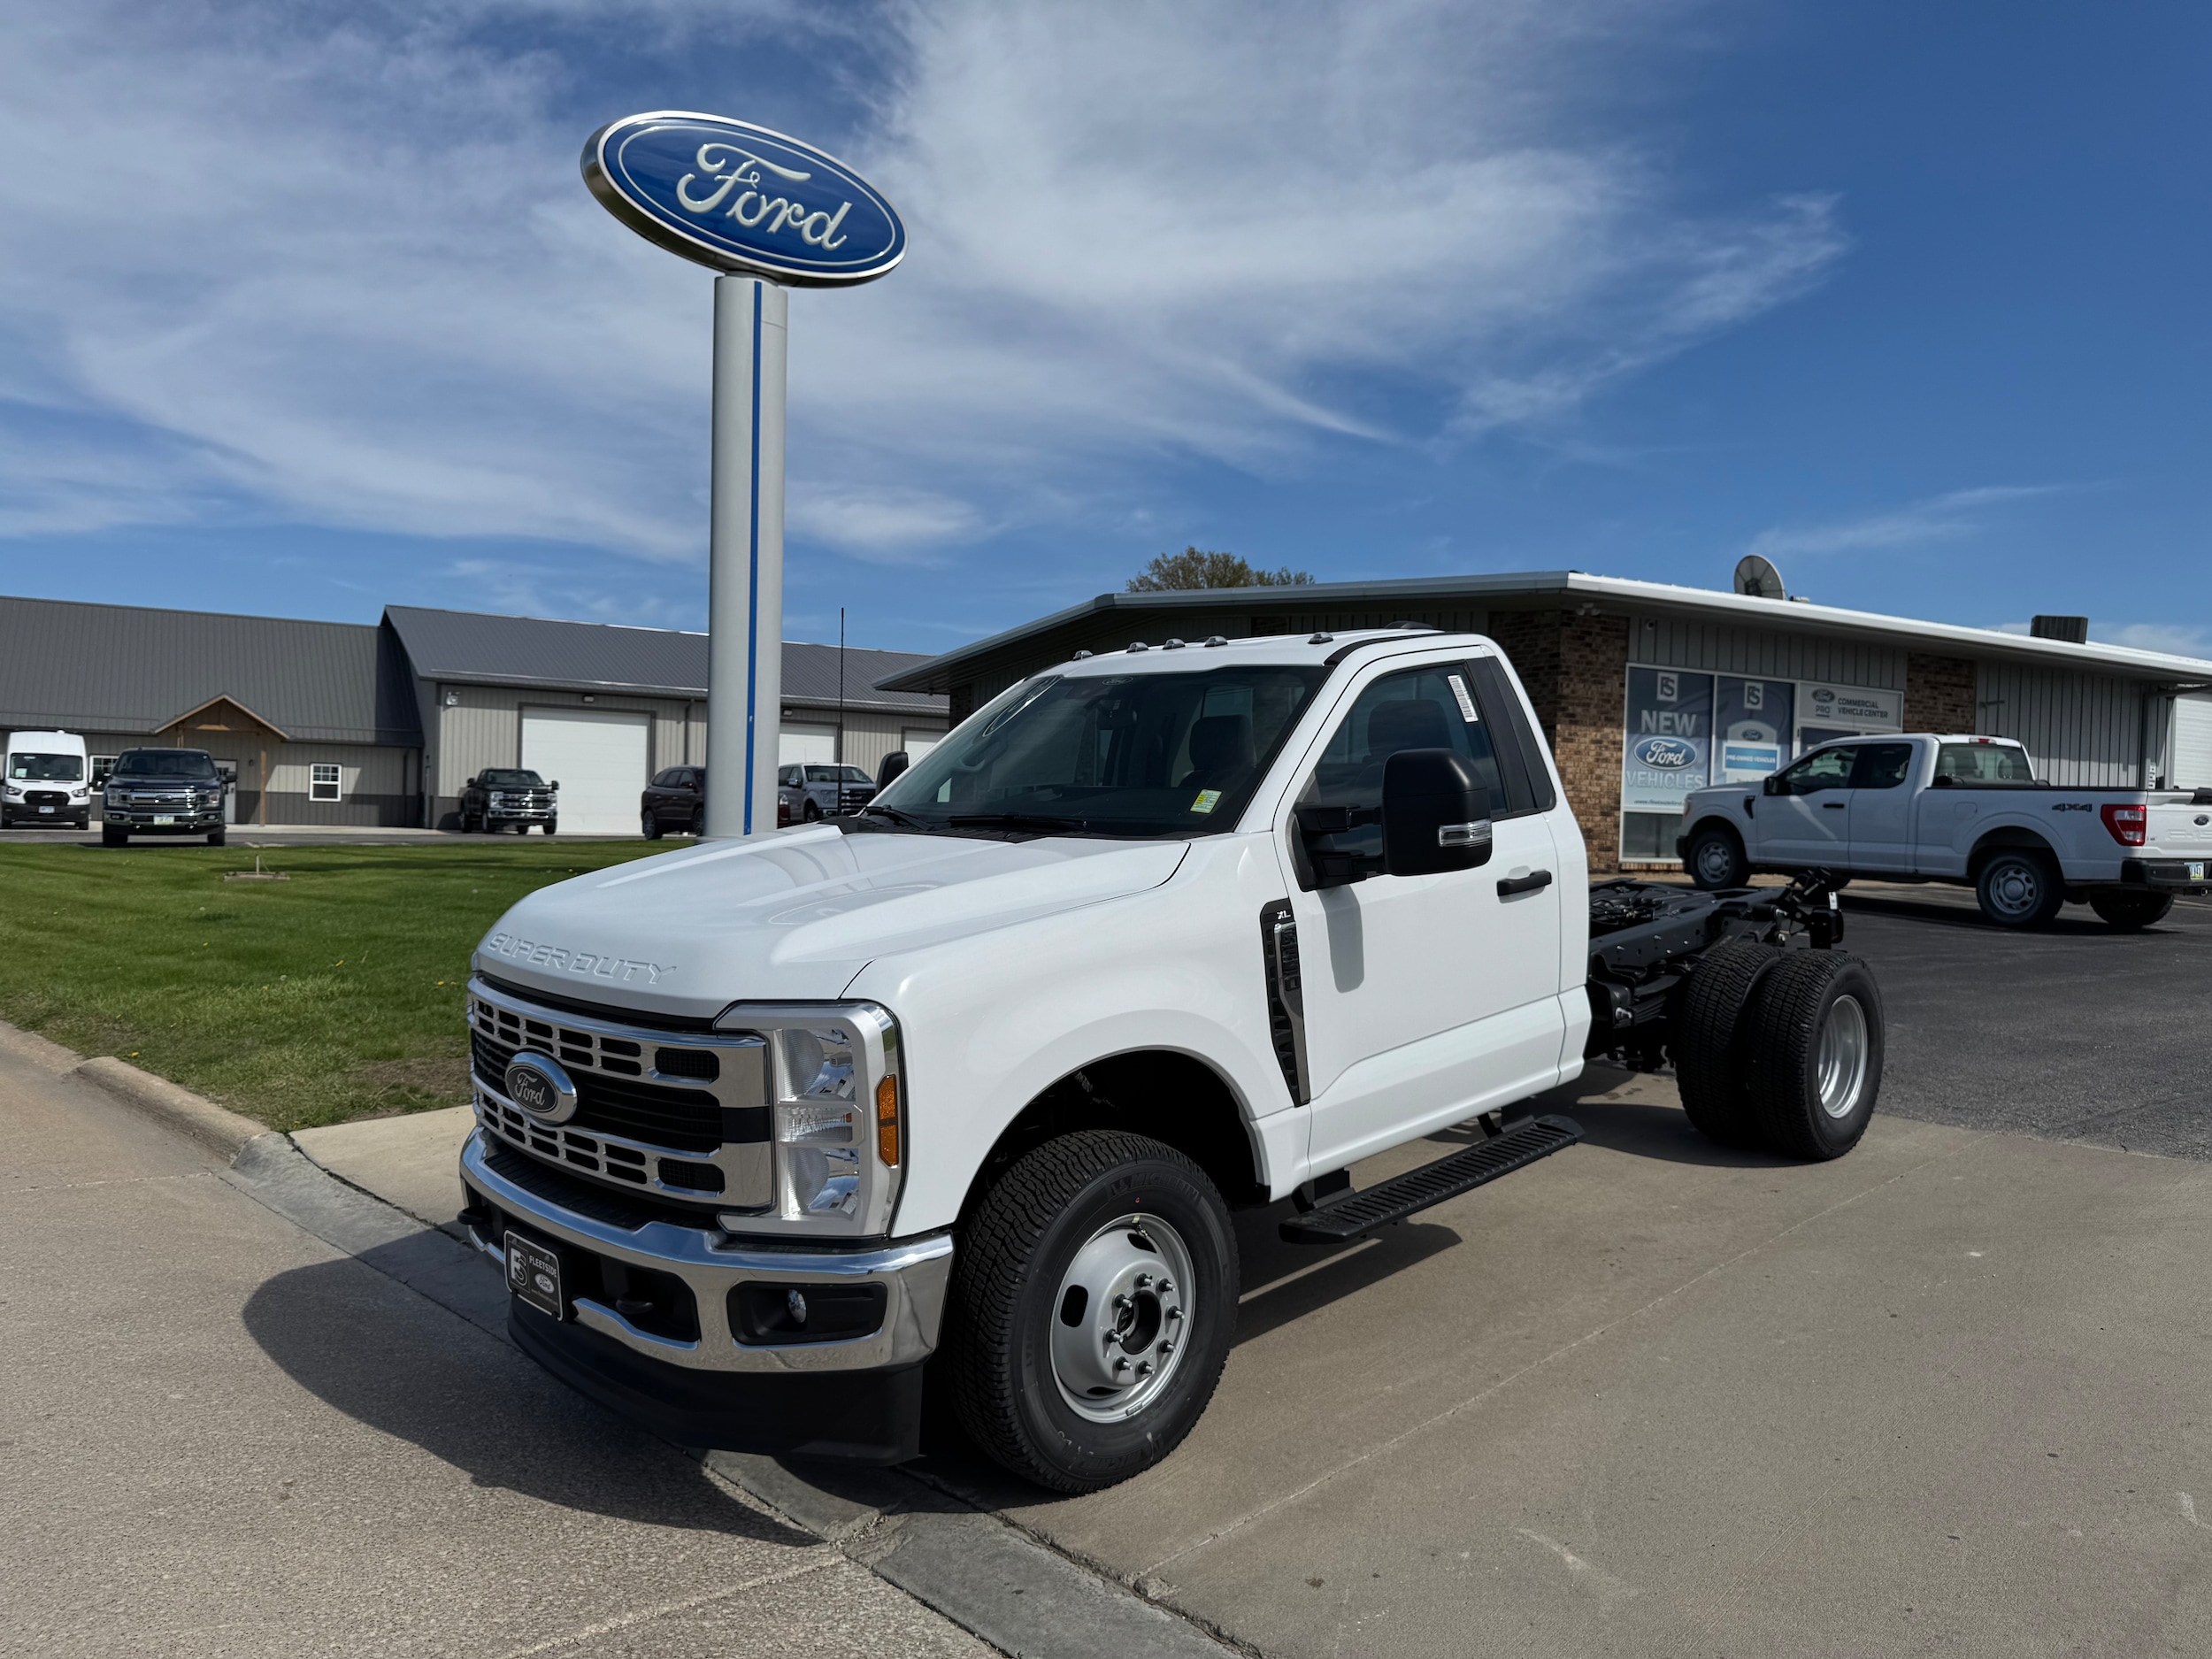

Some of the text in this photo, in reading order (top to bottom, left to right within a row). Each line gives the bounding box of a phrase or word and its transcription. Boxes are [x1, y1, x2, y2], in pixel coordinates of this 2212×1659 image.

[676, 142, 853, 251] Ford
[1816, 704, 1831, 714] PRO
[1838, 697, 1878, 709] COMMERCIAL
[1838, 706, 1888, 718] VEHICLE CENTER
[1640, 709, 1697, 736] NEW
[1646, 740, 1686, 765] Ford
[1626, 771, 1703, 790] VEHICLES
[1277, 910, 1292, 920] XL
[488, 933, 677, 984] SUPER DUTY
[514, 1071, 546, 1106] Ford
[529, 1255, 557, 1279] FLEETSIDE
